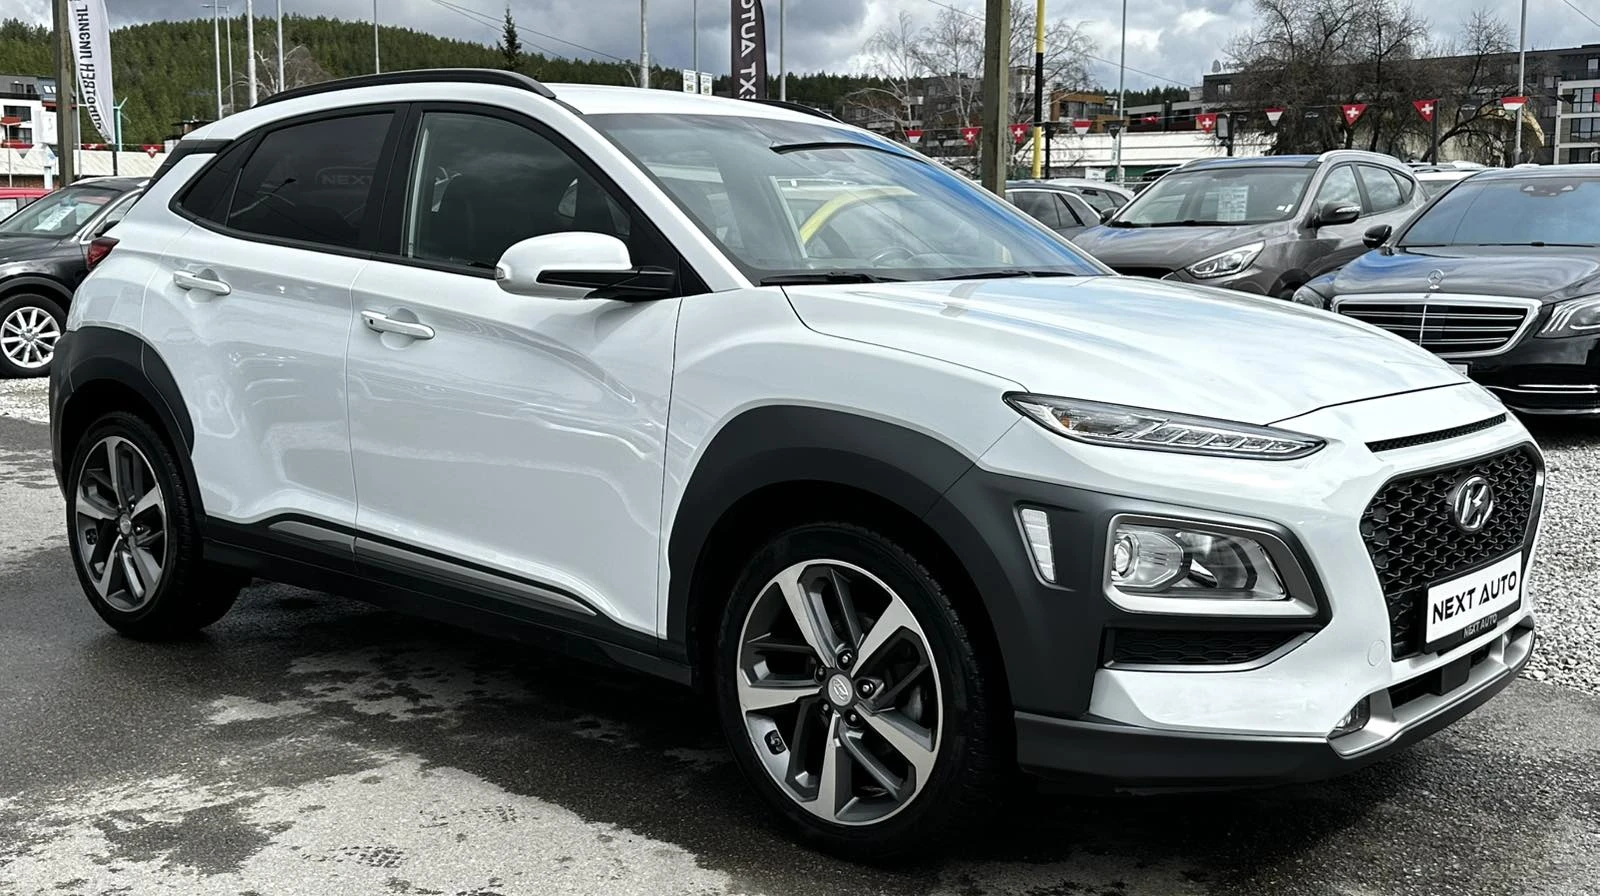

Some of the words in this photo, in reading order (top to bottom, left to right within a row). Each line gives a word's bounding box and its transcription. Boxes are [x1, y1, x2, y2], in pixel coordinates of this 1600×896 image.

[1432, 587, 1476, 624] NEXT
[1478, 571, 1517, 606] AUTO
[1463, 622, 1481, 638] NEXT
[1480, 613, 1498, 629] AUTO
